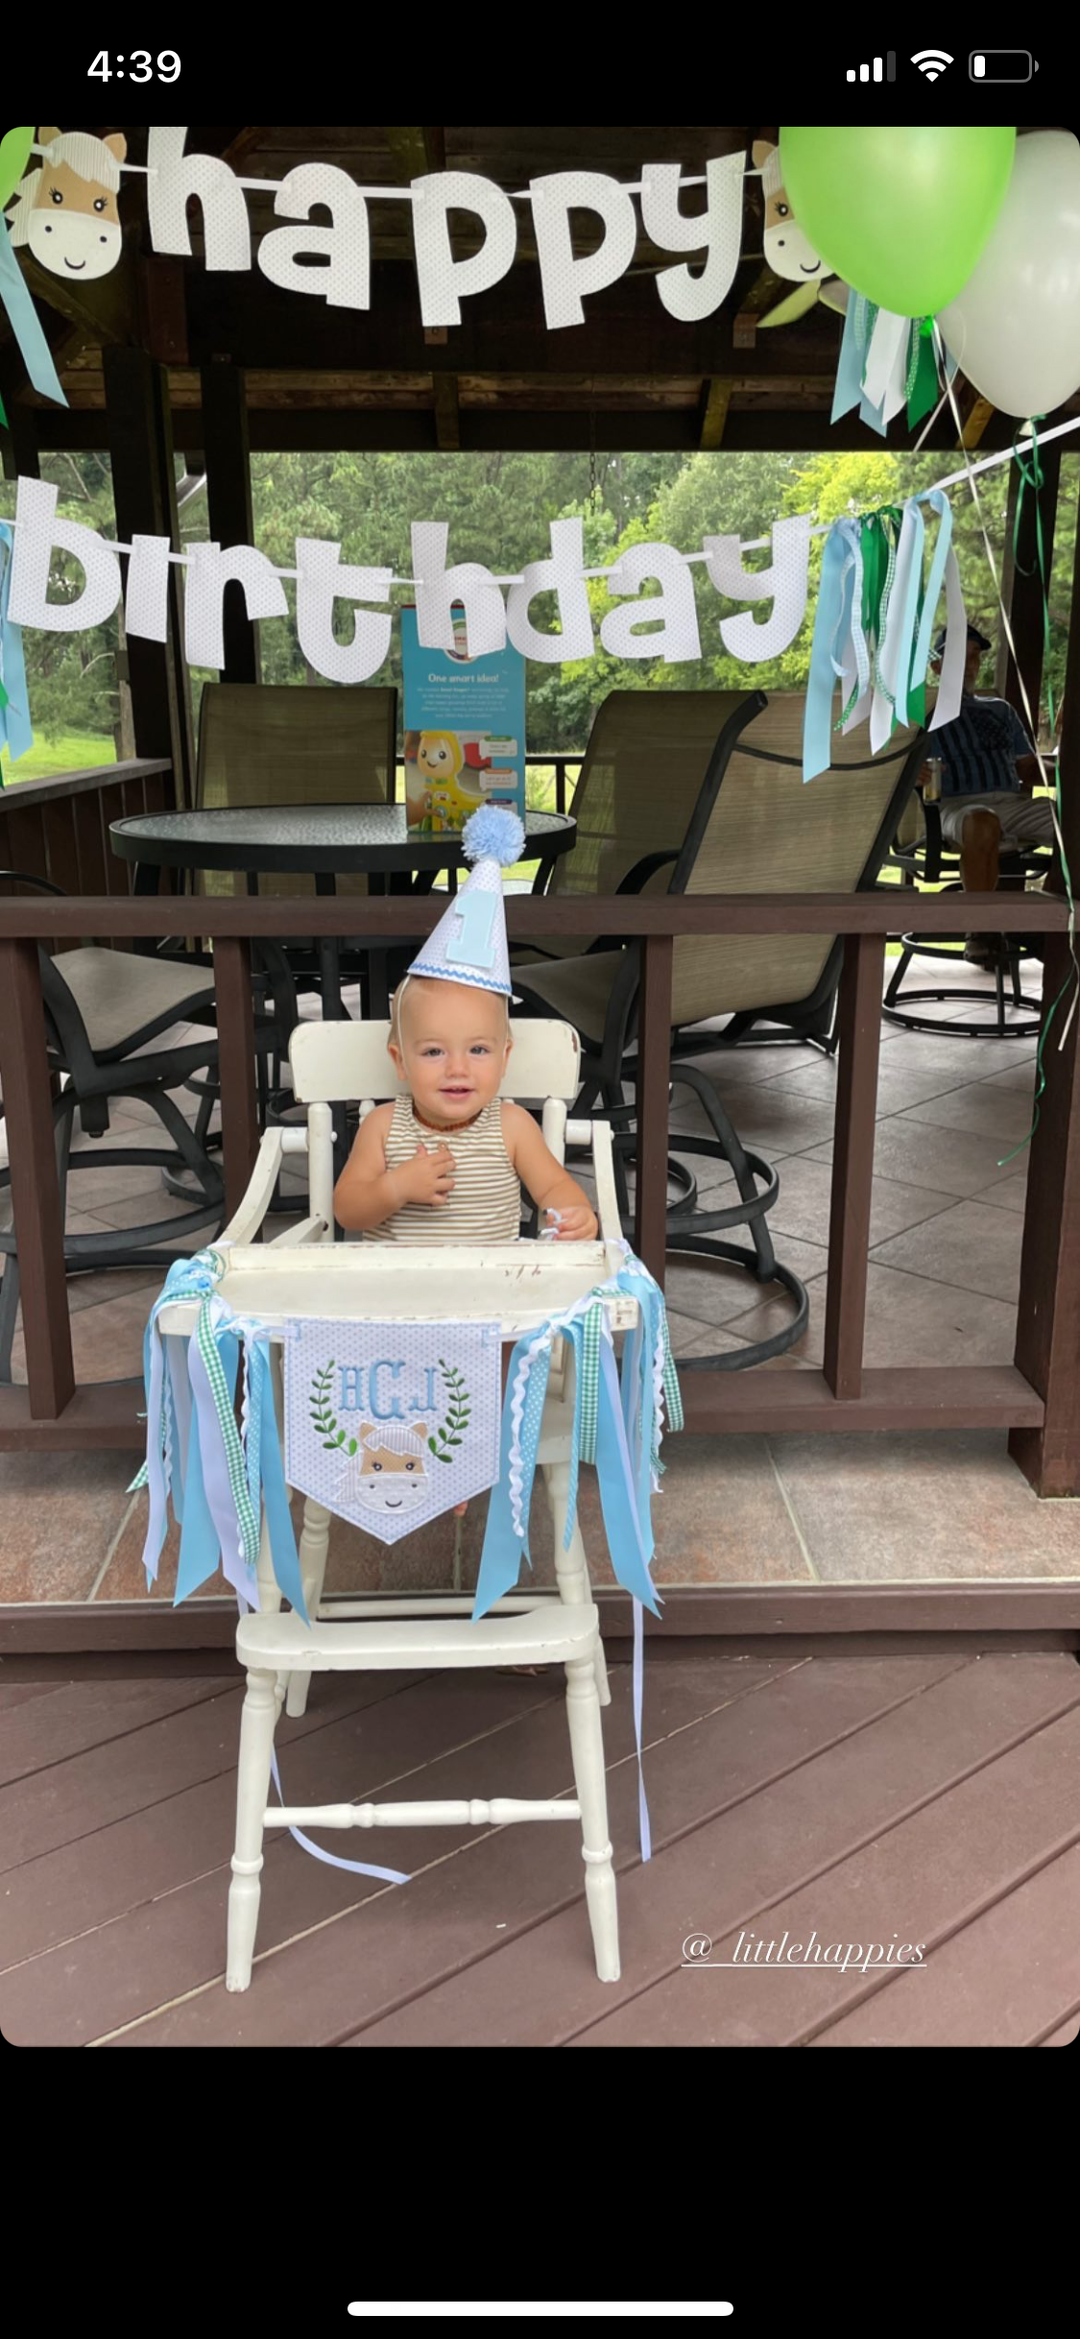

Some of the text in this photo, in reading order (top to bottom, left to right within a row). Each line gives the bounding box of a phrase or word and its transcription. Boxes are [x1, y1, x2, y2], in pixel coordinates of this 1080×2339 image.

[147, 127, 747, 330] happy
[7, 475, 811, 684] birthday
[428, 673, 499, 683] One smart idea!
[445, 890, 498, 969] 1
